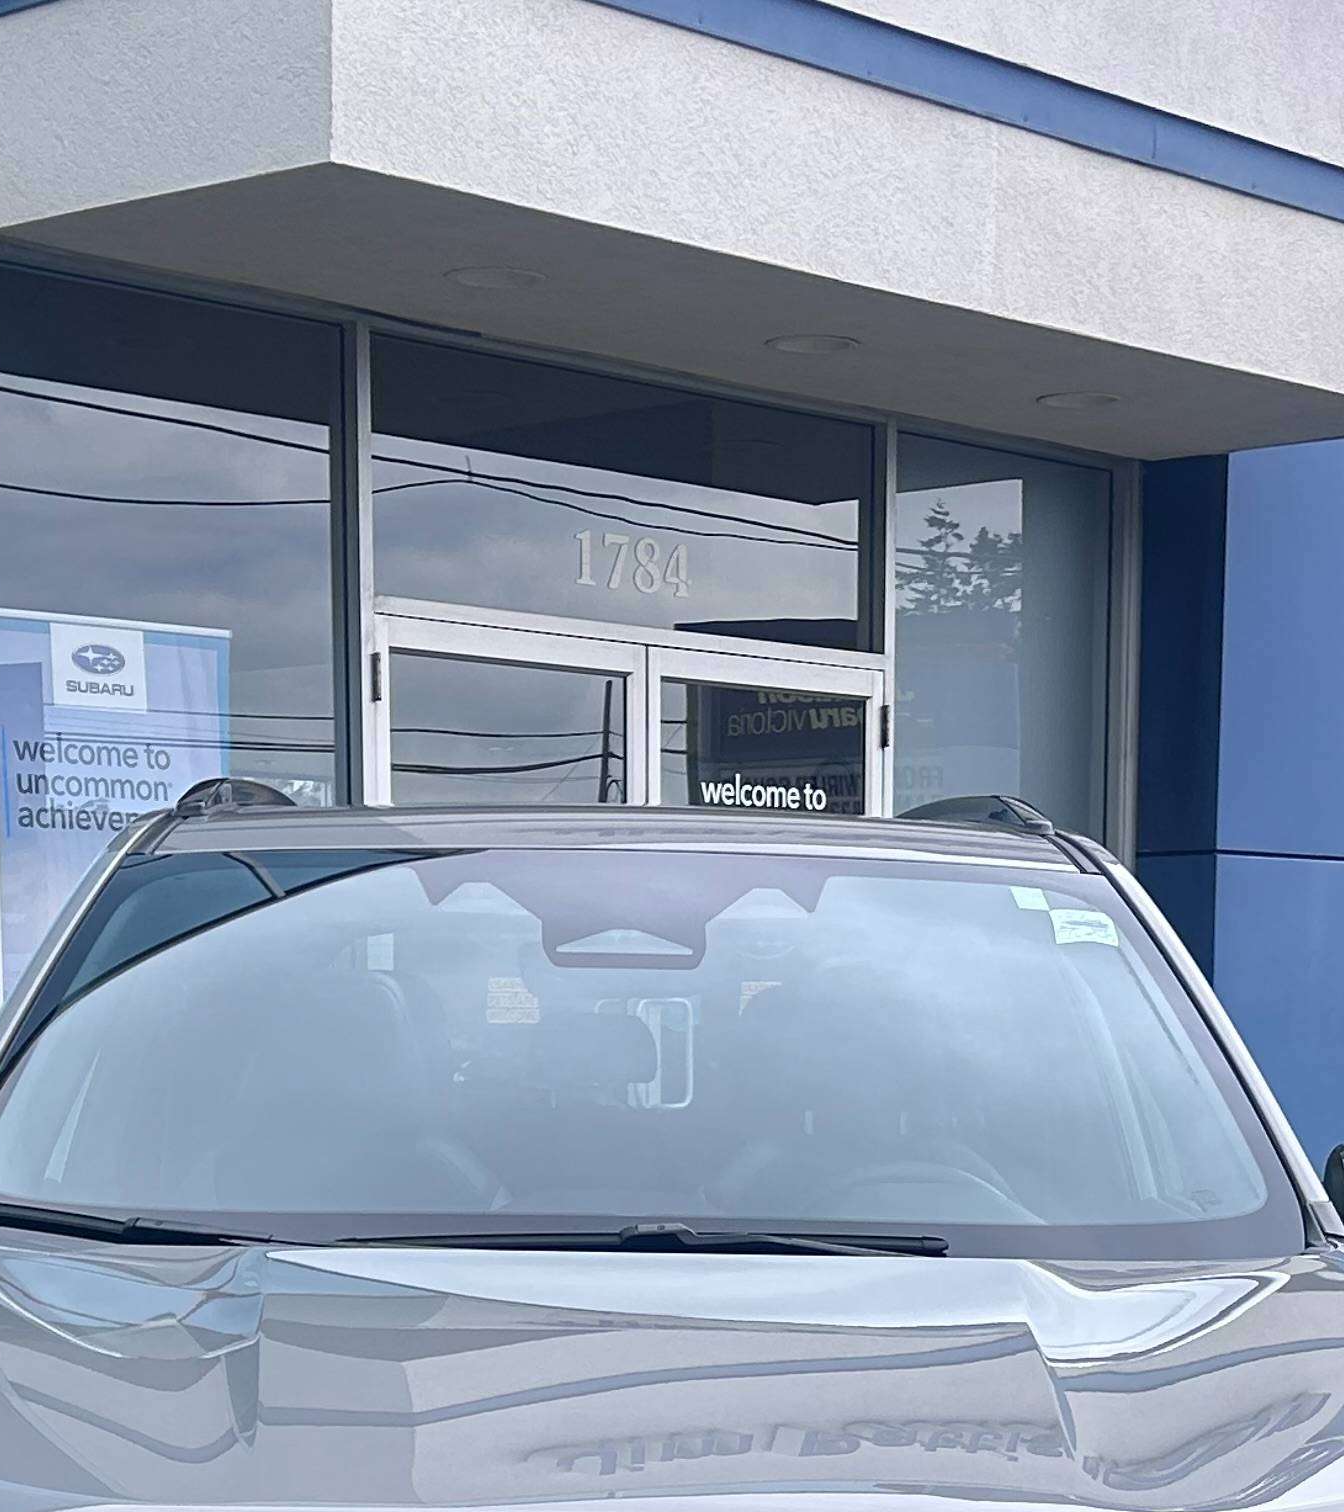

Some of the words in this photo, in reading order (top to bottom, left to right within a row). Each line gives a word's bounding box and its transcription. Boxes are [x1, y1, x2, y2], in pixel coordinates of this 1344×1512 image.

[574, 528, 692, 598] 1784
[66, 680, 134, 696] SUBARU
[13, 733, 138, 768] welcome
[144, 743, 171, 770] to
[17, 772, 169, 801] uncommon
[701, 773, 799, 809] welcome
[804, 784, 827, 811] to
